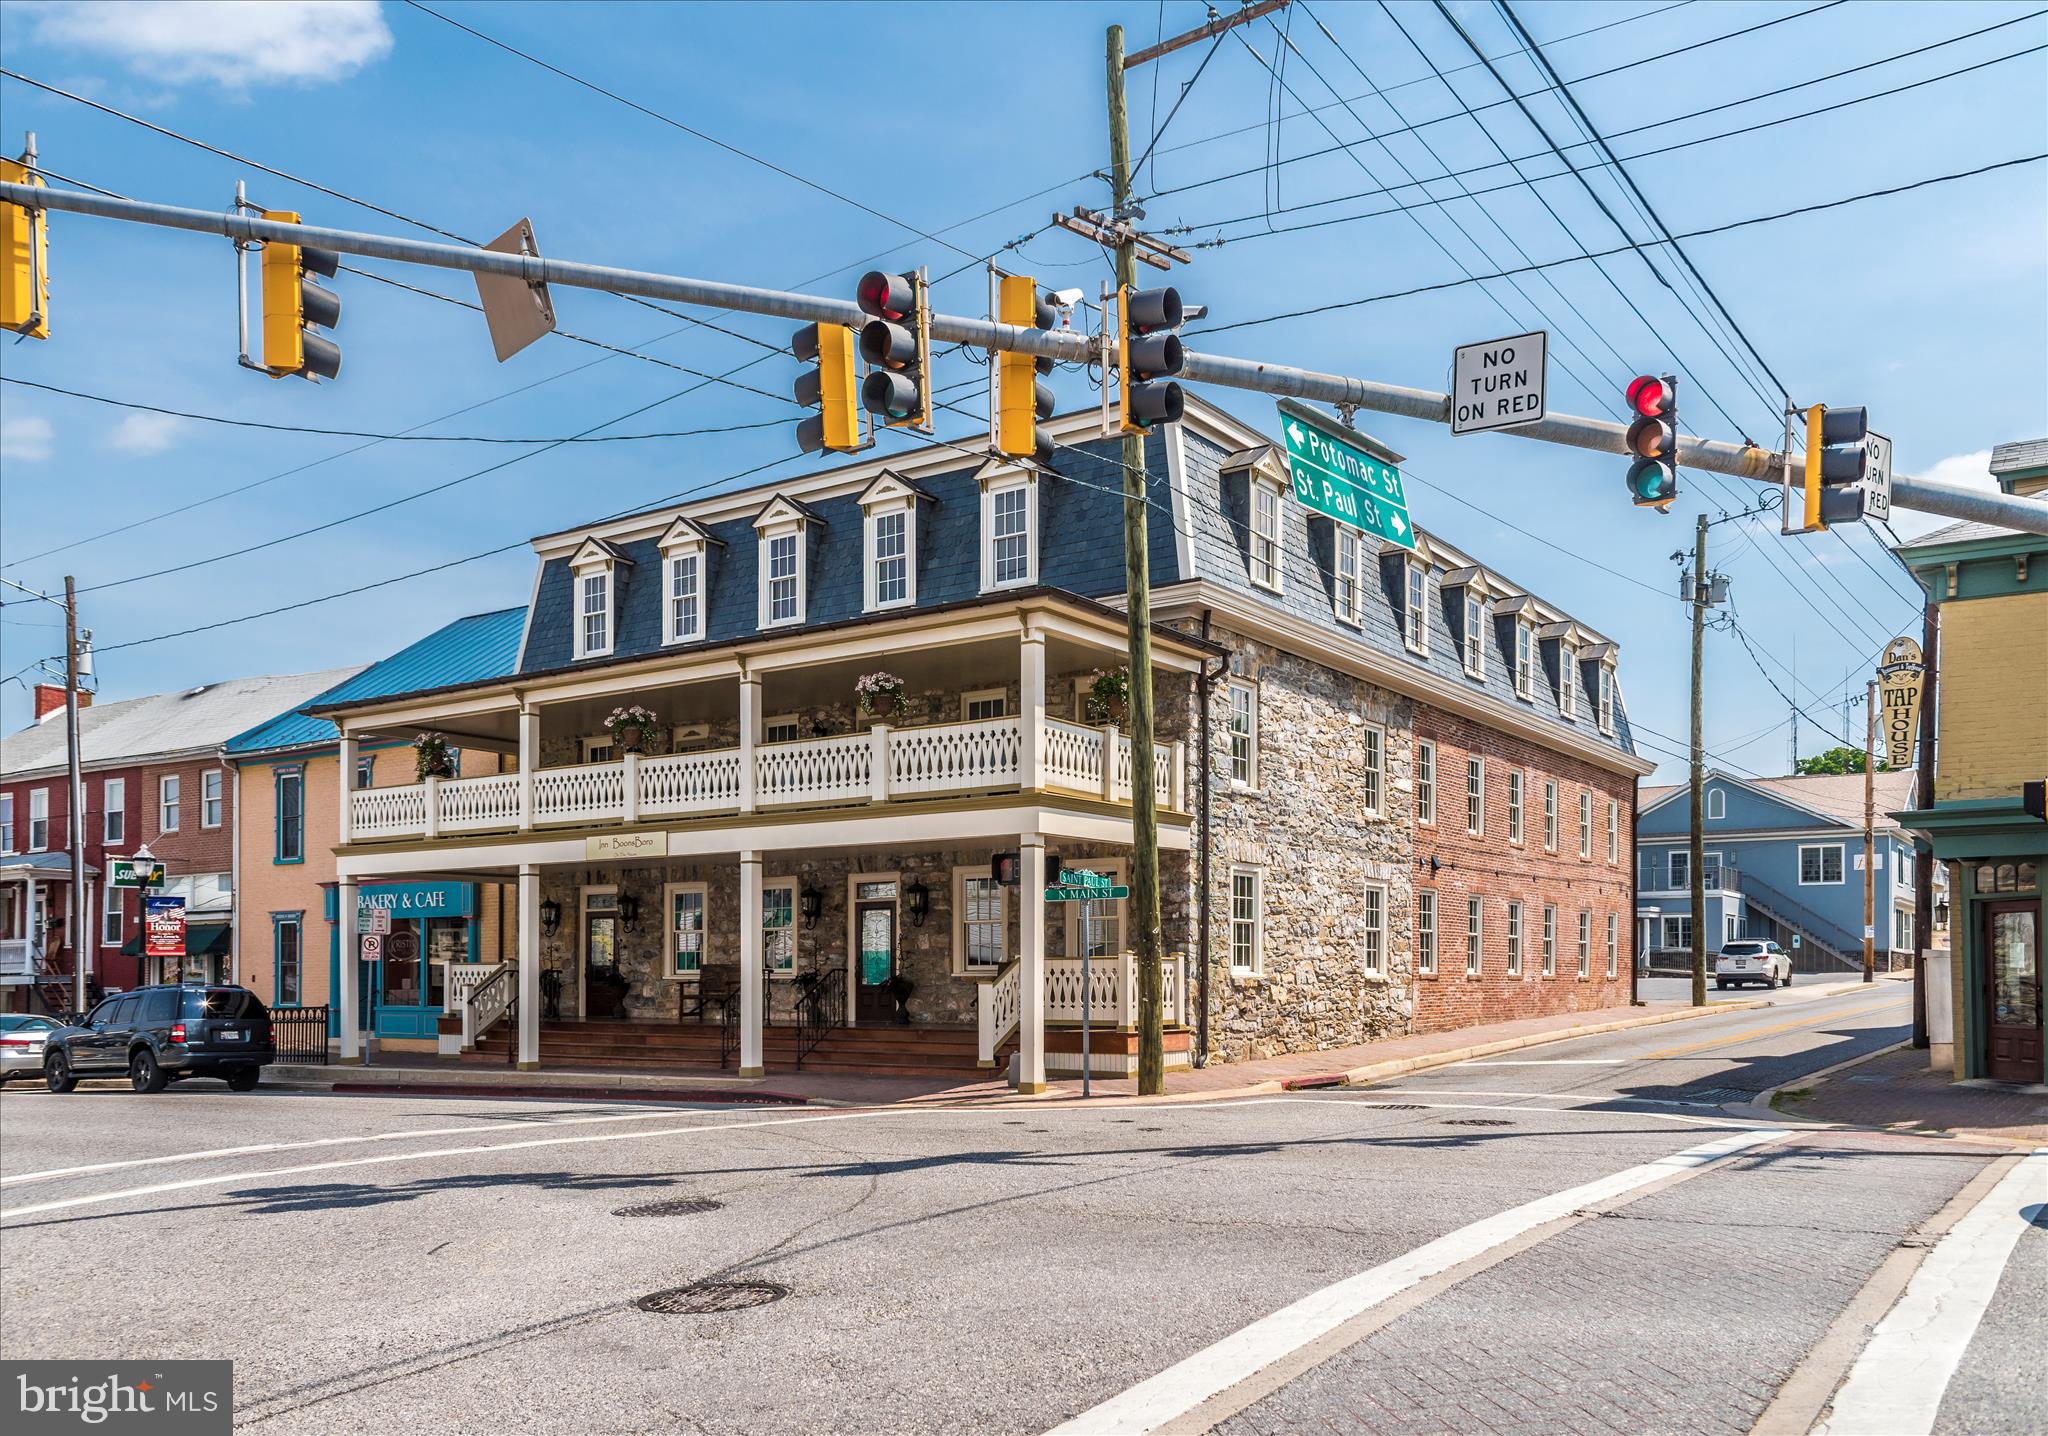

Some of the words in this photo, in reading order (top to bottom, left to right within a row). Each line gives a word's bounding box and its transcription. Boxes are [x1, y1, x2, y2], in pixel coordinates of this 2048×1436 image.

[1483, 348, 1515, 368] NO
[1471, 370, 1527, 394] TURN
[1458, 402, 1484, 422] ON
[1497, 393, 1539, 415] RED
[1866, 439, 1880, 460] NO
[1308, 430, 1376, 486] Potomac
[1382, 468, 1400, 498] St
[1866, 466, 1884, 486] URN
[1296, 468, 1319, 501] St.
[1322, 480, 1358, 518] Paul
[1364, 499, 1382, 528] St
[1870, 491, 1888, 510] RED
[1888, 652, 1917, 664] Dan's
[1884, 687, 1918, 708] TAP
[1891, 708, 1912, 766] HOUSE
[599, 839, 609, 850] Inn
[612, 836, 654, 849] BoonsBoro
[1062, 872, 1082, 885] SAINT
[1083, 875, 1100, 888] PAUL
[1101, 877, 1109, 888] ST
[357, 893, 398, 909] BAKERY
[402, 892, 412, 909] &
[415, 891, 446, 908] CAFE
[1059, 889, 1066, 899] N
[1070, 888, 1099, 899] MAIN
[1102, 887, 1114, 897] ST
[150, 922, 181, 931] Honor
